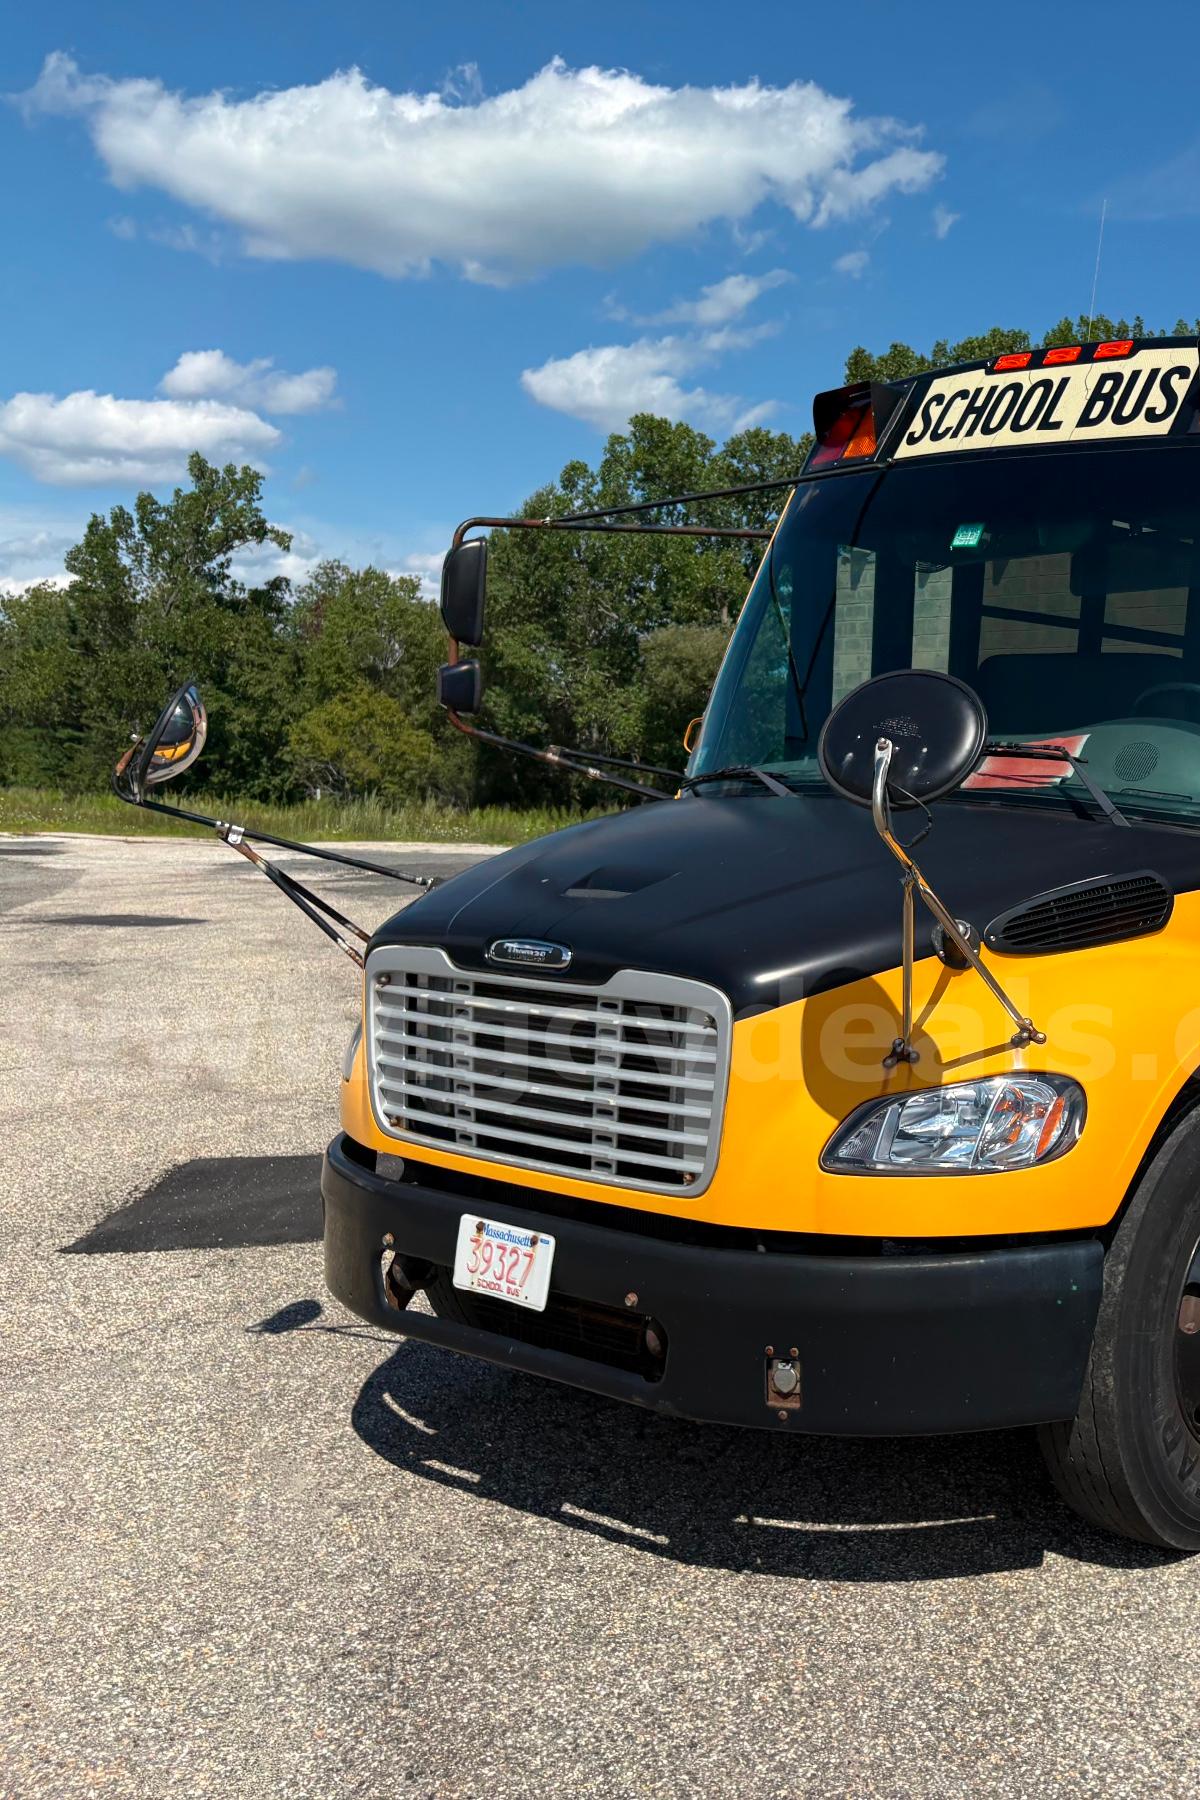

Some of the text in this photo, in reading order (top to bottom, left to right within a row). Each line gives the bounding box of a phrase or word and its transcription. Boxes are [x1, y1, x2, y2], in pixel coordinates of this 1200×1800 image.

[906, 365, 1191, 446] SCHOOL BUS
[466, 1235, 536, 1288] 39327
[477, 1278, 522, 1297] SCHOOL BUS
